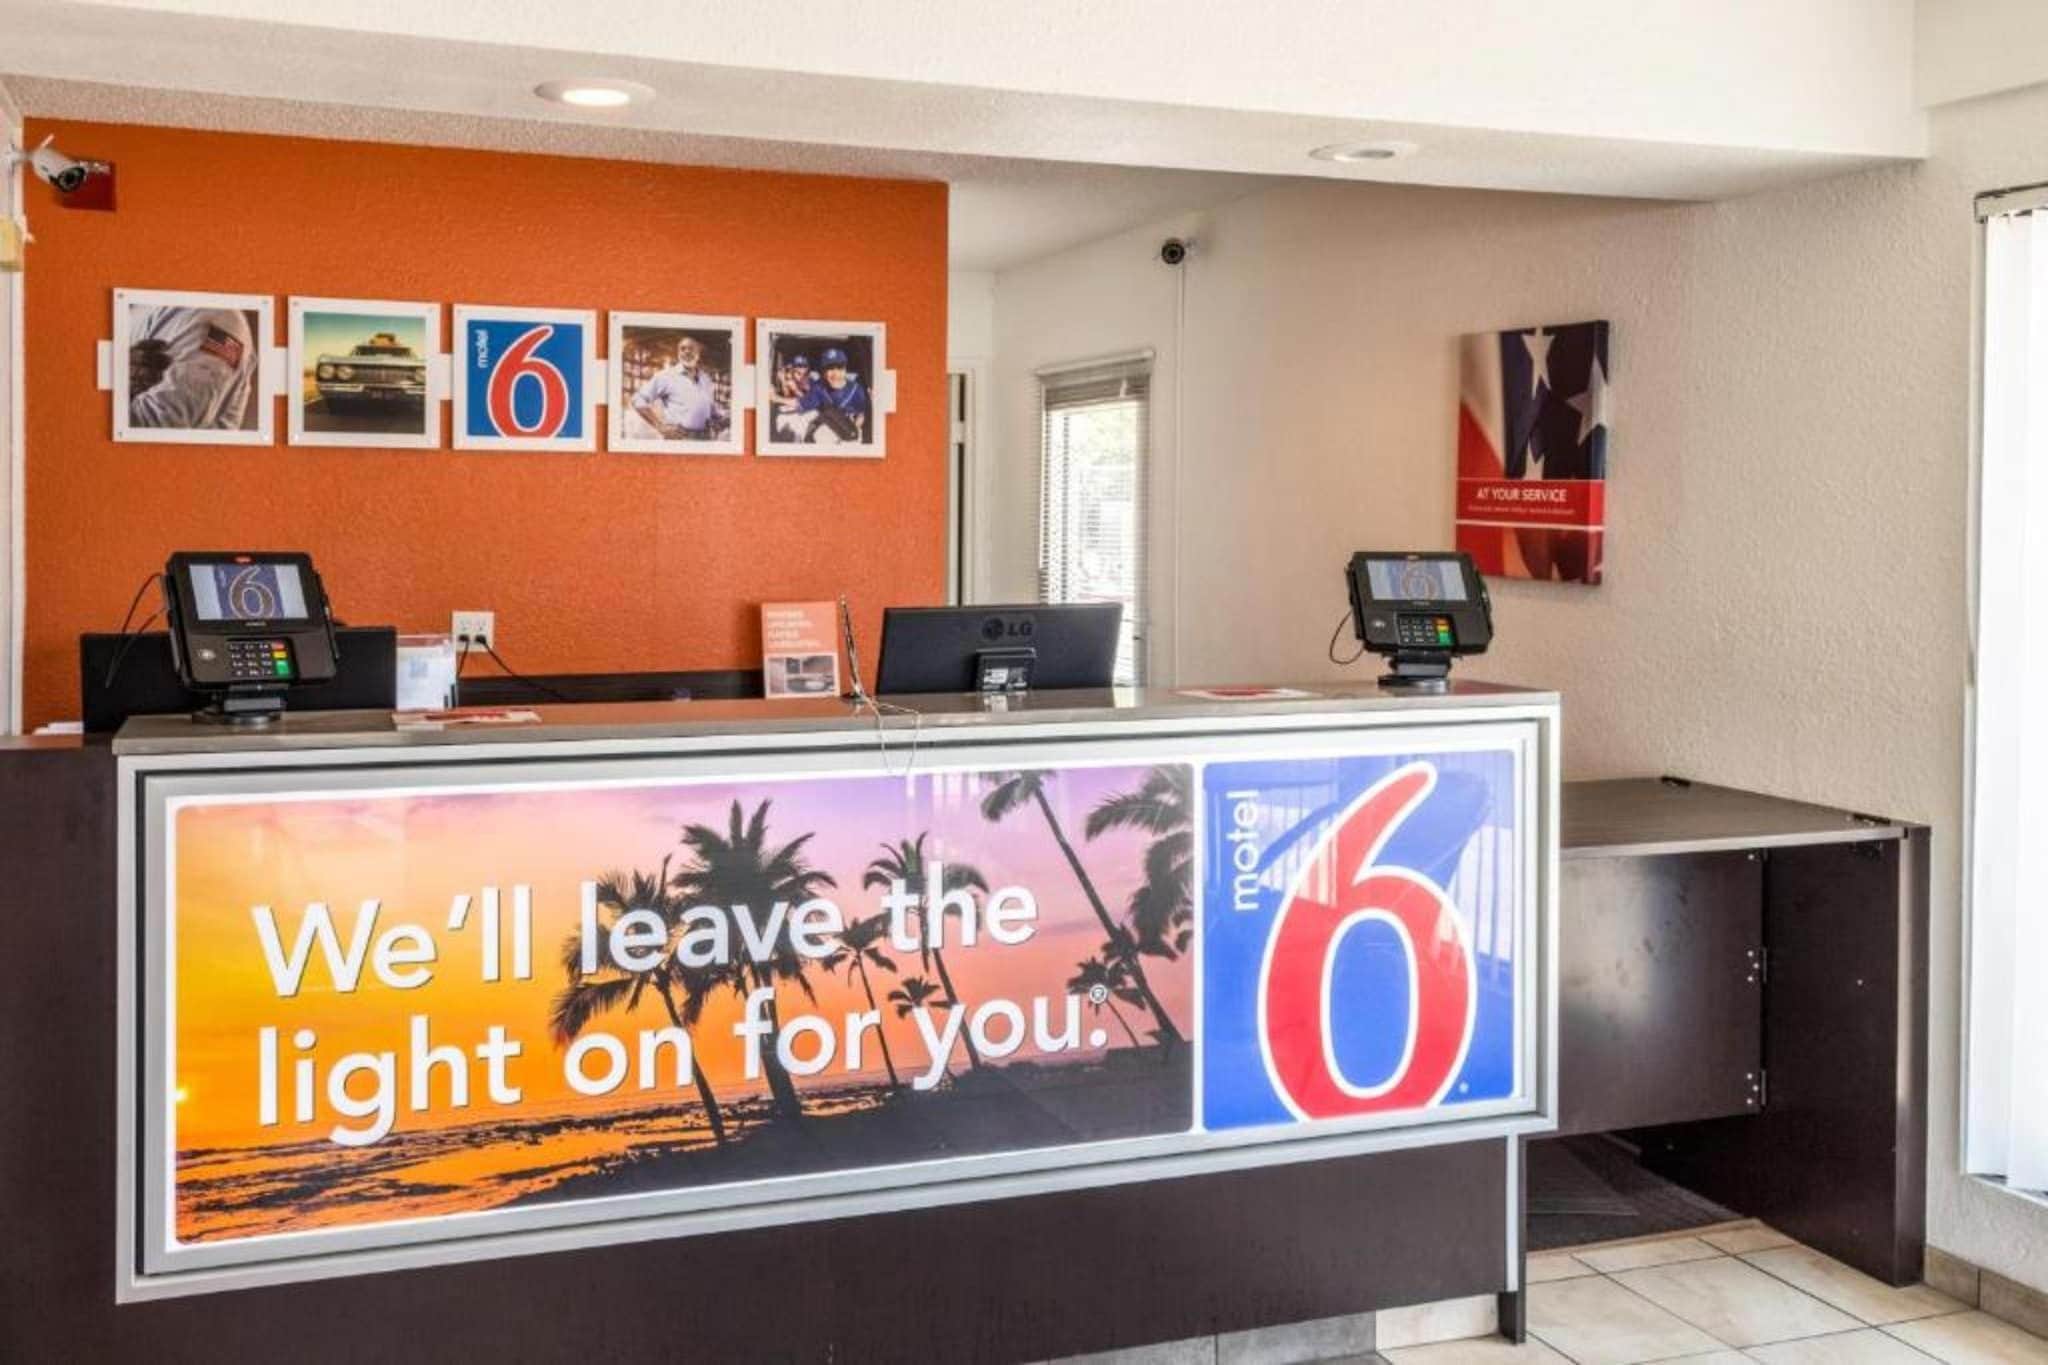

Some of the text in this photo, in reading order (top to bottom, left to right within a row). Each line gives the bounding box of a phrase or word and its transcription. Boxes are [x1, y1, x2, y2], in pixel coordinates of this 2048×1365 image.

[475, 325, 568, 439] motel 6
[1477, 487, 1567, 503] AT YOUR SERVICE
[228, 564, 275, 620] 6
[1007, 621, 1033, 637] LG
[251, 861, 1038, 997] We'll leave the
[1226, 760, 1478, 1122] motel 6
[258, 1014, 522, 1147] light
[563, 1026, 694, 1096] on
[733, 986, 881, 1080] for
